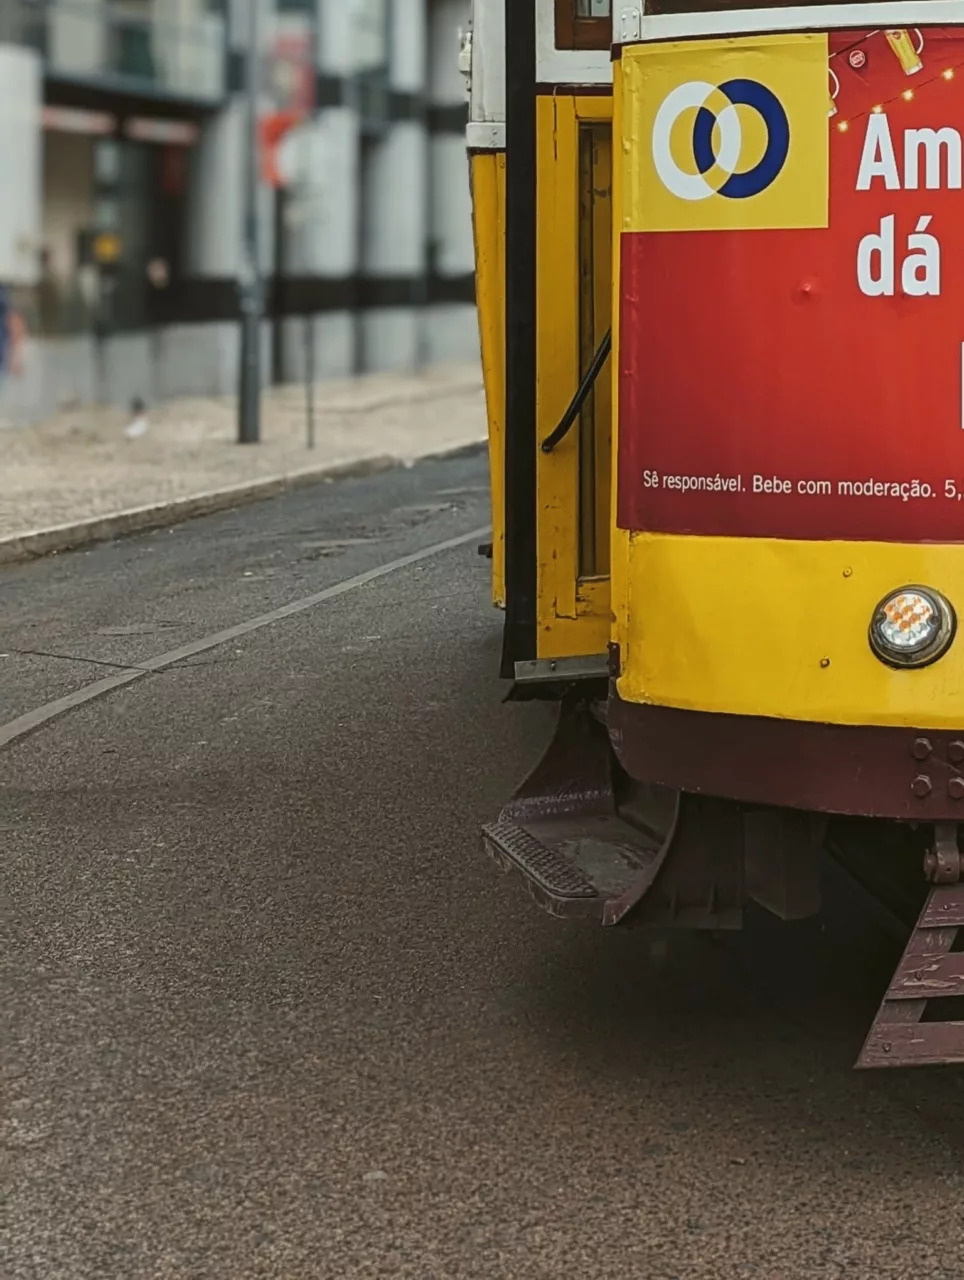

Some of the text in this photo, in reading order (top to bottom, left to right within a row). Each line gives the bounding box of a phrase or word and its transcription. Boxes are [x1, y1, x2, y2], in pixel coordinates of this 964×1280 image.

[856, 213, 940, 297] dá
[643, 470, 659, 489] Sê
[662, 473, 746, 493] responsável.
[752, 474, 792, 494] Bebe
[797, 480, 832, 495] com
[838, 479, 936, 503] moderação.
